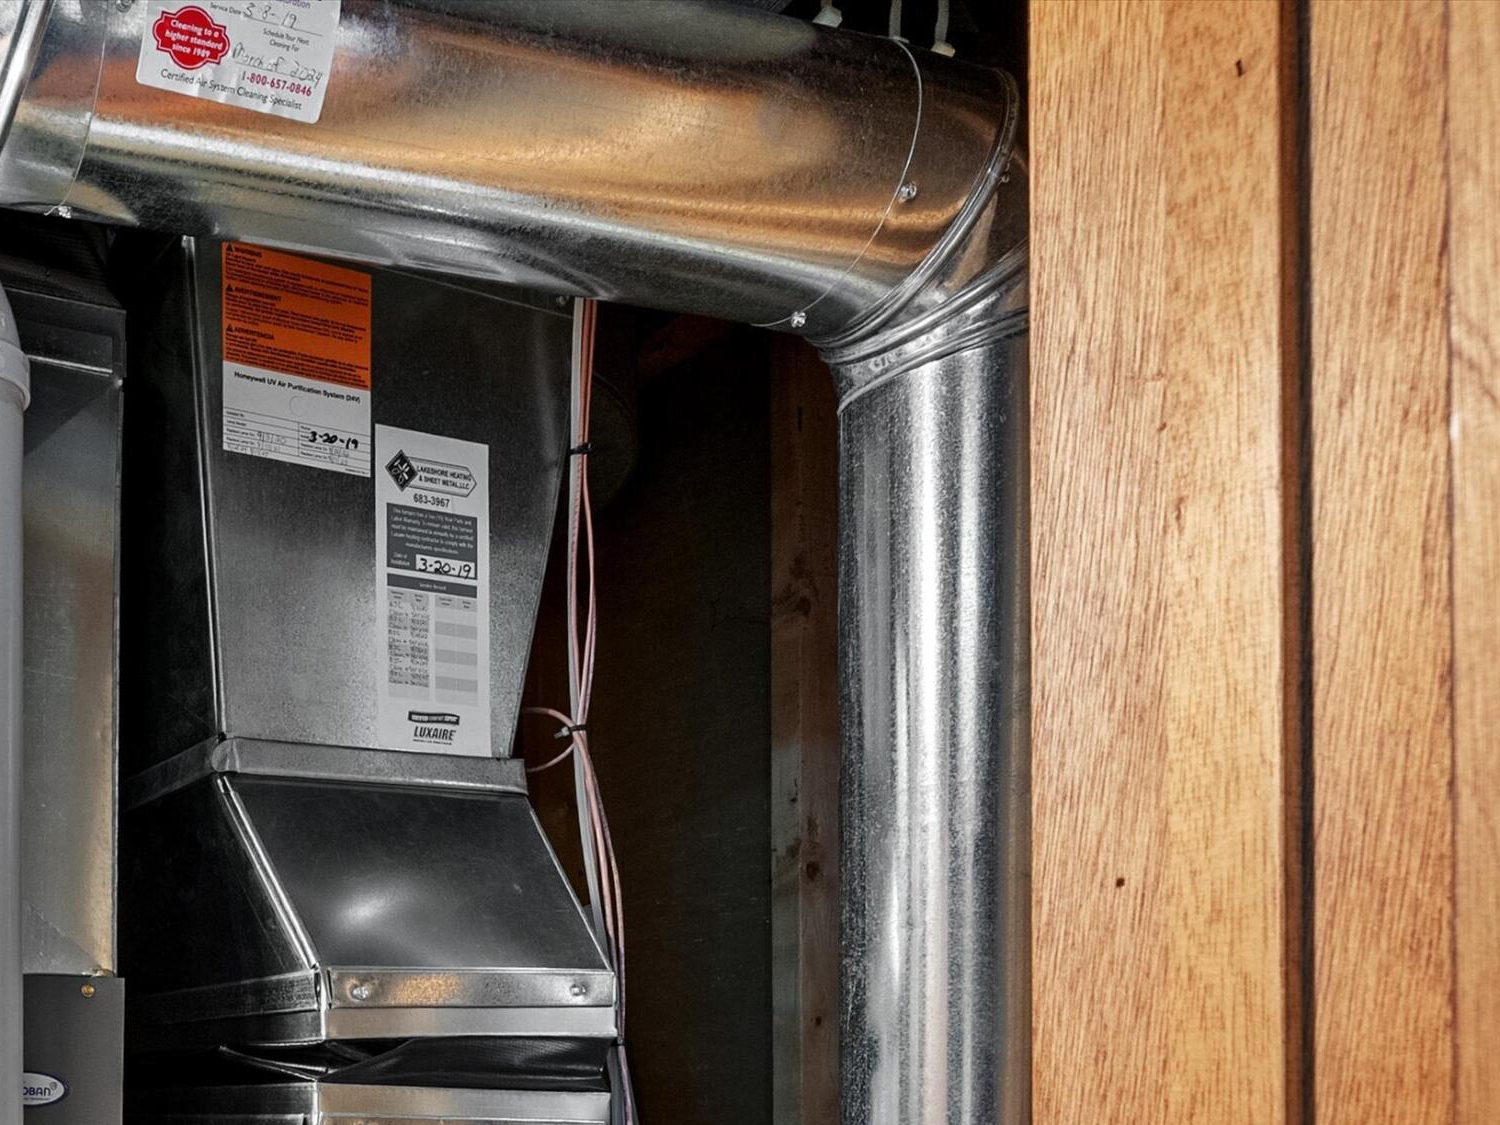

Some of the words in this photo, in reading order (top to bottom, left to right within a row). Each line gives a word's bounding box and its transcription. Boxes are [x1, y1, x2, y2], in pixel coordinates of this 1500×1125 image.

[171, 19, 203, 36] Cleaning
[204, 28, 212, 36] to
[165, 30, 189, 44] higher
[190, 35, 223, 51] standard
[172, 44, 191, 55] since
[161, 68, 194, 84] Certified
[197, 77, 207, 89] Air
[208, 80, 235, 97] System
[237, 87, 268, 103] Cleaning
[269, 95, 303, 110] Specialist
[242, 73, 312, 97] 1-800-657-0846
[234, 371, 266, 385] Honeywell
[267, 378, 276, 386] UV
[277, 380, 286, 388] Air
[287, 383, 322, 396] Purification
[323, 390, 345, 401] System
[309, 431, 358, 449] 3-20-19
[413, 493, 449, 508] 683-3967
[419, 558, 471, 579] 3-20-19
[414, 726, 456, 740] LUXAIRE
[23, 1086, 51, 1096] OBAN
